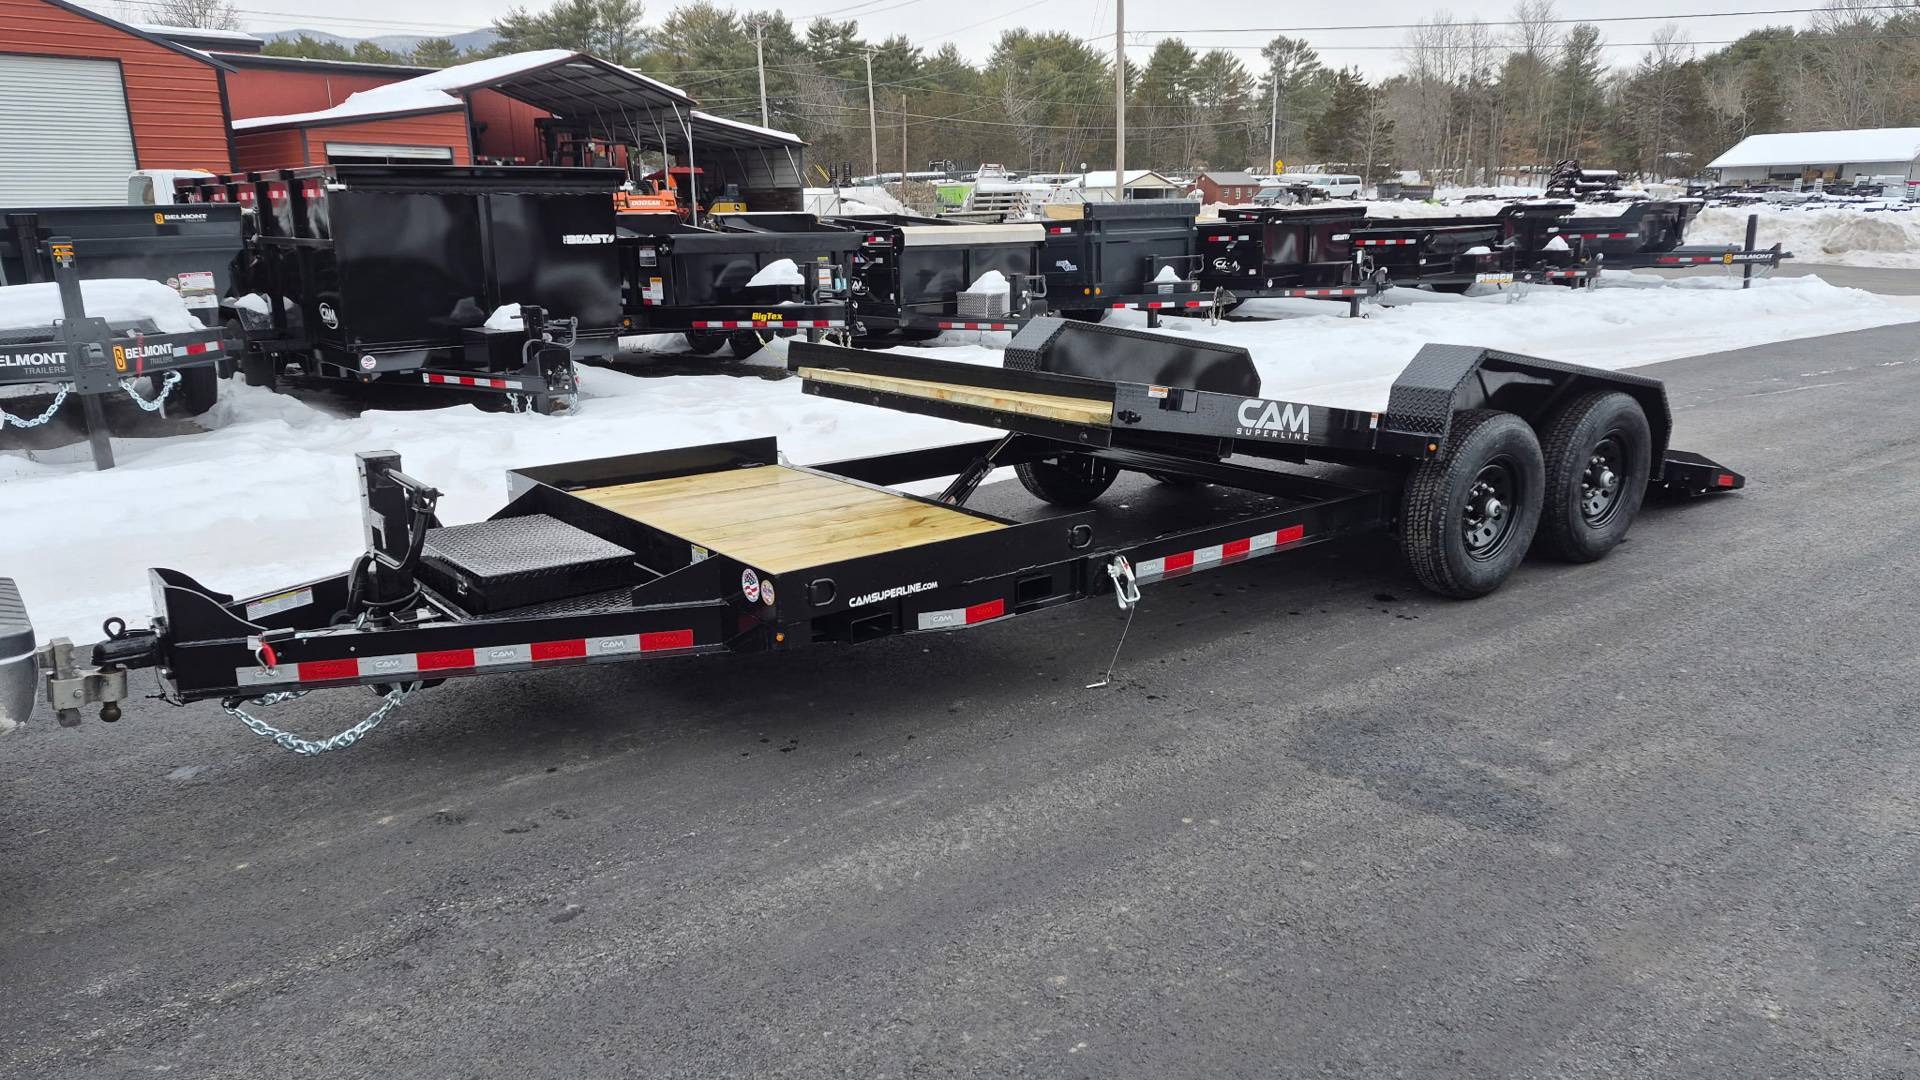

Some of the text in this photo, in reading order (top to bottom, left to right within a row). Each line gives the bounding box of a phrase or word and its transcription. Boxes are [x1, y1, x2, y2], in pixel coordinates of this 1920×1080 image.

[566, 233, 611, 244] BEAST
[125, 343, 173, 359] BELMONT
[24, 366, 66, 375] TRAILERS
[1237, 399, 1310, 434] CAM
[1236, 428, 1310, 441] SUPERLINE
[601, 640, 625, 648] CAM
[490, 650, 515, 658] CAM
[375, 660, 400, 668] CAM
